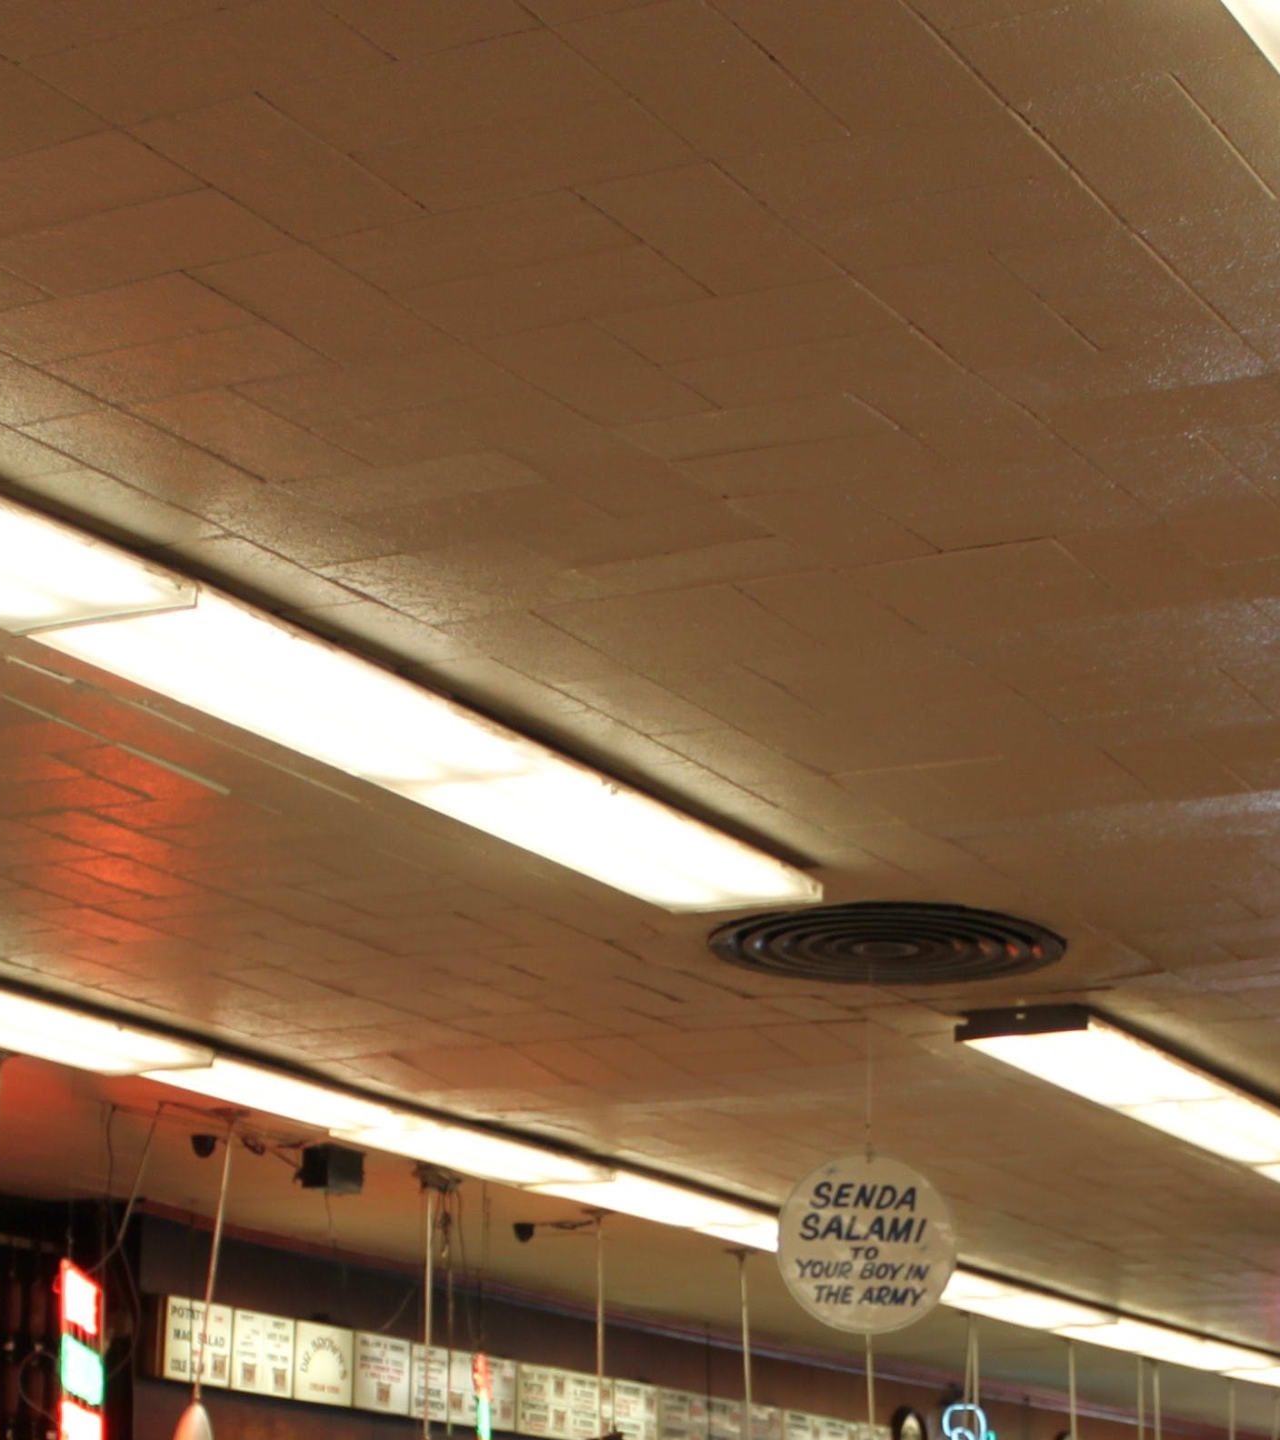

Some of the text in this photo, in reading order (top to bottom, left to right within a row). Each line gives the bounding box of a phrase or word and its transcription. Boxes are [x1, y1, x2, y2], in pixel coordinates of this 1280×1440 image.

[799, 1212, 927, 1243] SALAMI
[850, 1247, 879, 1261] TO
[795, 1259, 930, 1281] YOUR BOY IN
[814, 1285, 927, 1307] THE ARMY
